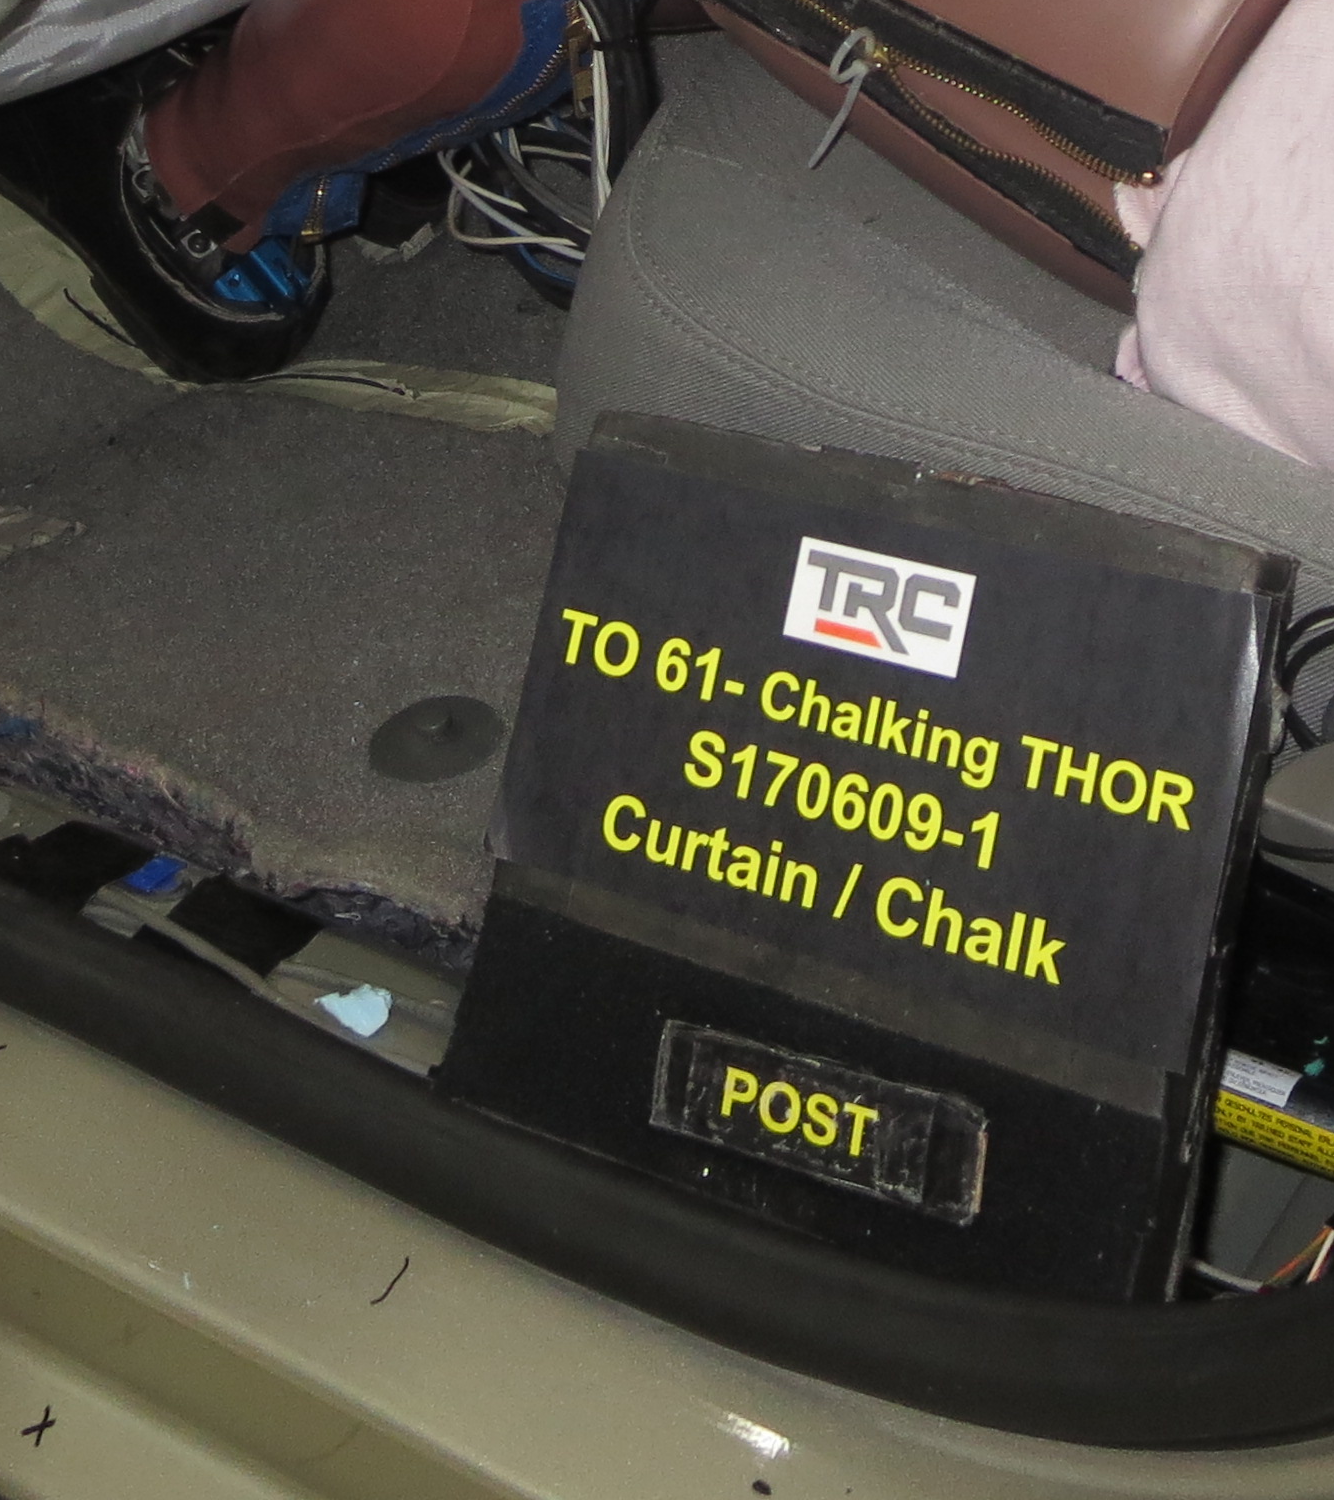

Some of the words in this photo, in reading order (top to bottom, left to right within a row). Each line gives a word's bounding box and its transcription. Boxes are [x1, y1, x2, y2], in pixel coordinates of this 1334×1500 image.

[807, 549, 962, 656] TRC
[562, 608, 639, 677] TO
[656, 637, 745, 702] 61-
[761, 670, 999, 790] Chalking
[1020, 734, 1194, 831] THOR
[684, 730, 1000, 870] S170609-1
[602, 794, 818, 910] Curtain
[832, 863, 864, 919] /
[875, 876, 1067, 985] Chalk
[720, 1066, 879, 1157] POST
